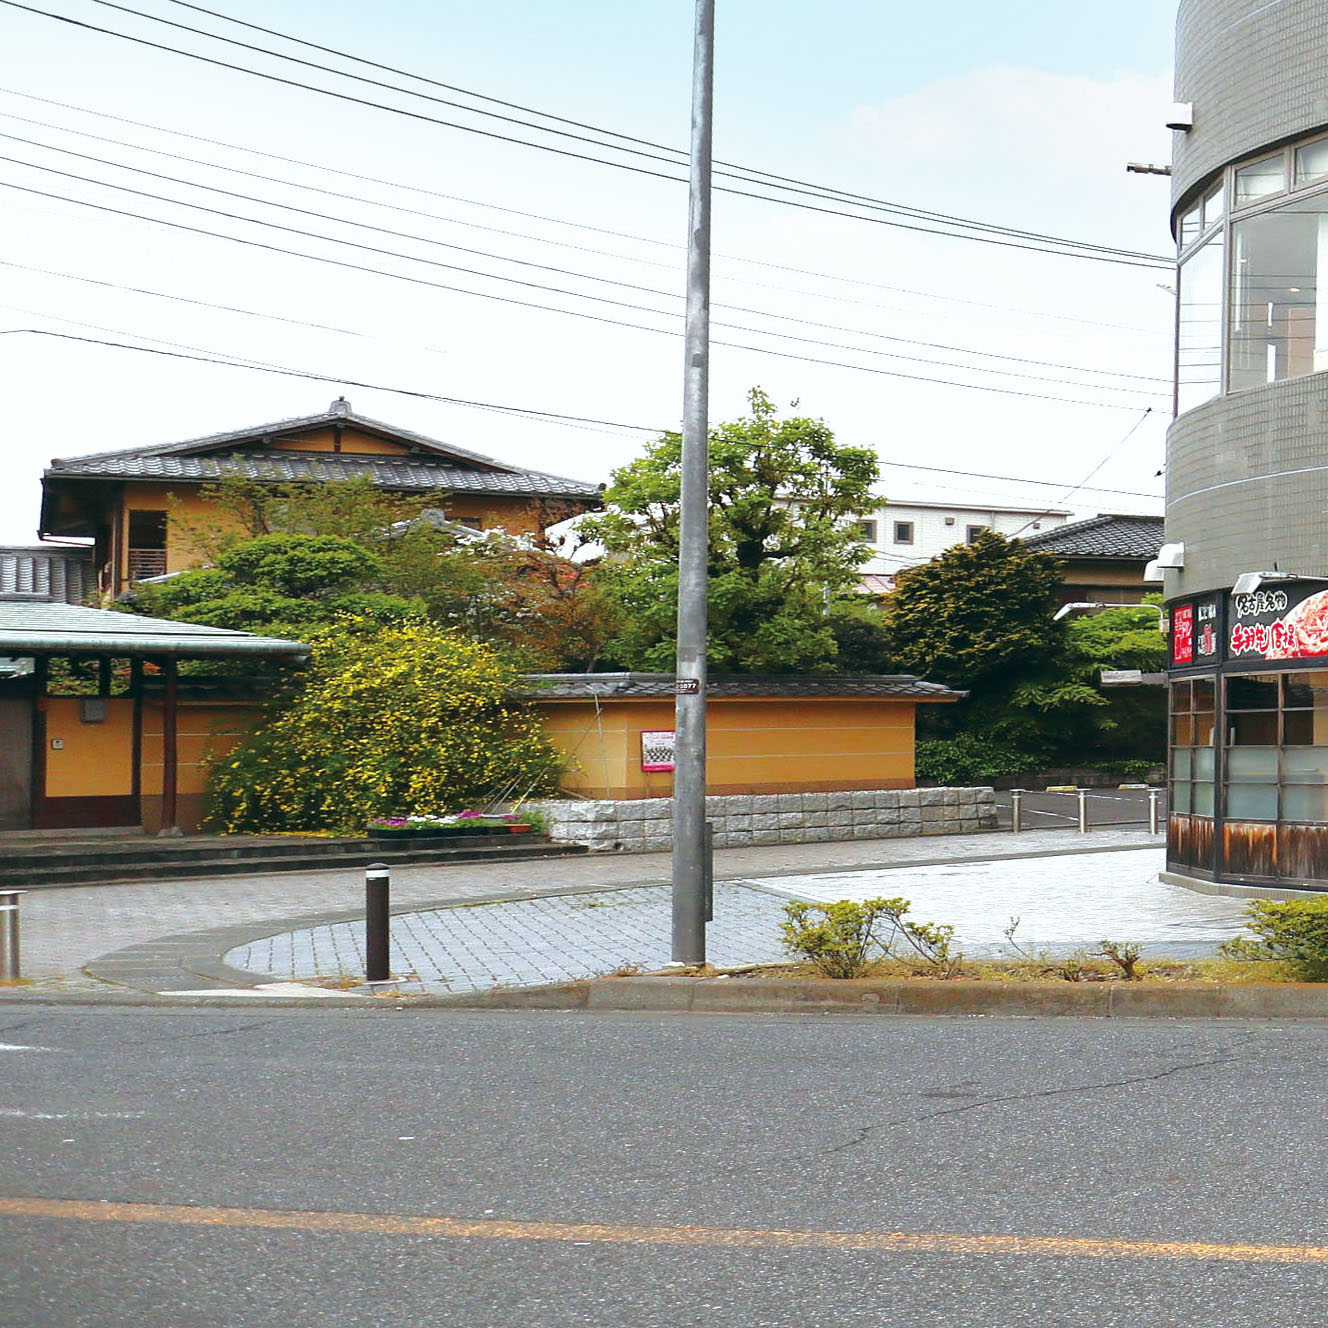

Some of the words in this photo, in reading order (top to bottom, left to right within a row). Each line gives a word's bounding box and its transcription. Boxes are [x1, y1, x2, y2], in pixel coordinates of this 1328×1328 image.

[1235, 590, 1288, 619] 名古屋名物
